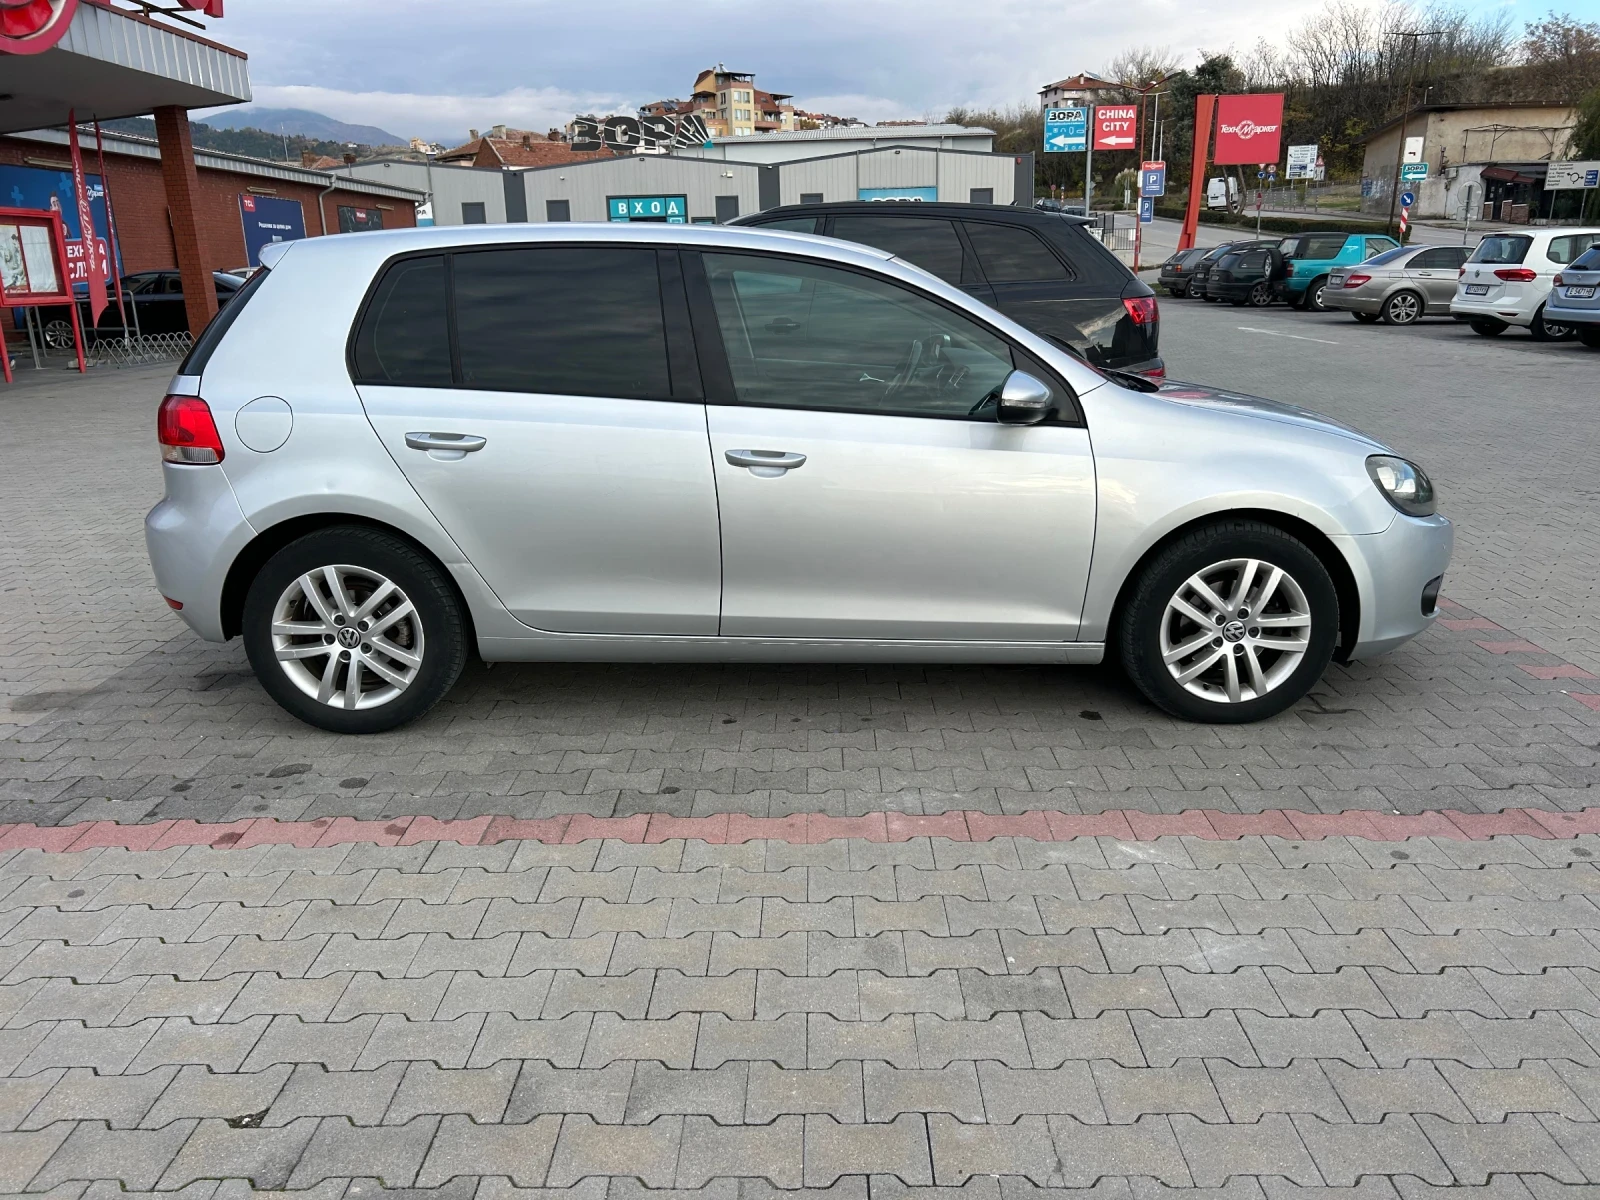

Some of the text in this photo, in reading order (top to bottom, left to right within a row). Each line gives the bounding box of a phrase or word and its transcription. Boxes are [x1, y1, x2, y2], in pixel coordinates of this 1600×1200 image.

[1048, 110, 1084, 121] ЗОРА
[1098, 109, 1135, 119] CHINA
[1102, 121, 1130, 131] CITY
[570, 115, 710, 151] ЗОРА
[618, 201, 679, 214] ВХОД
